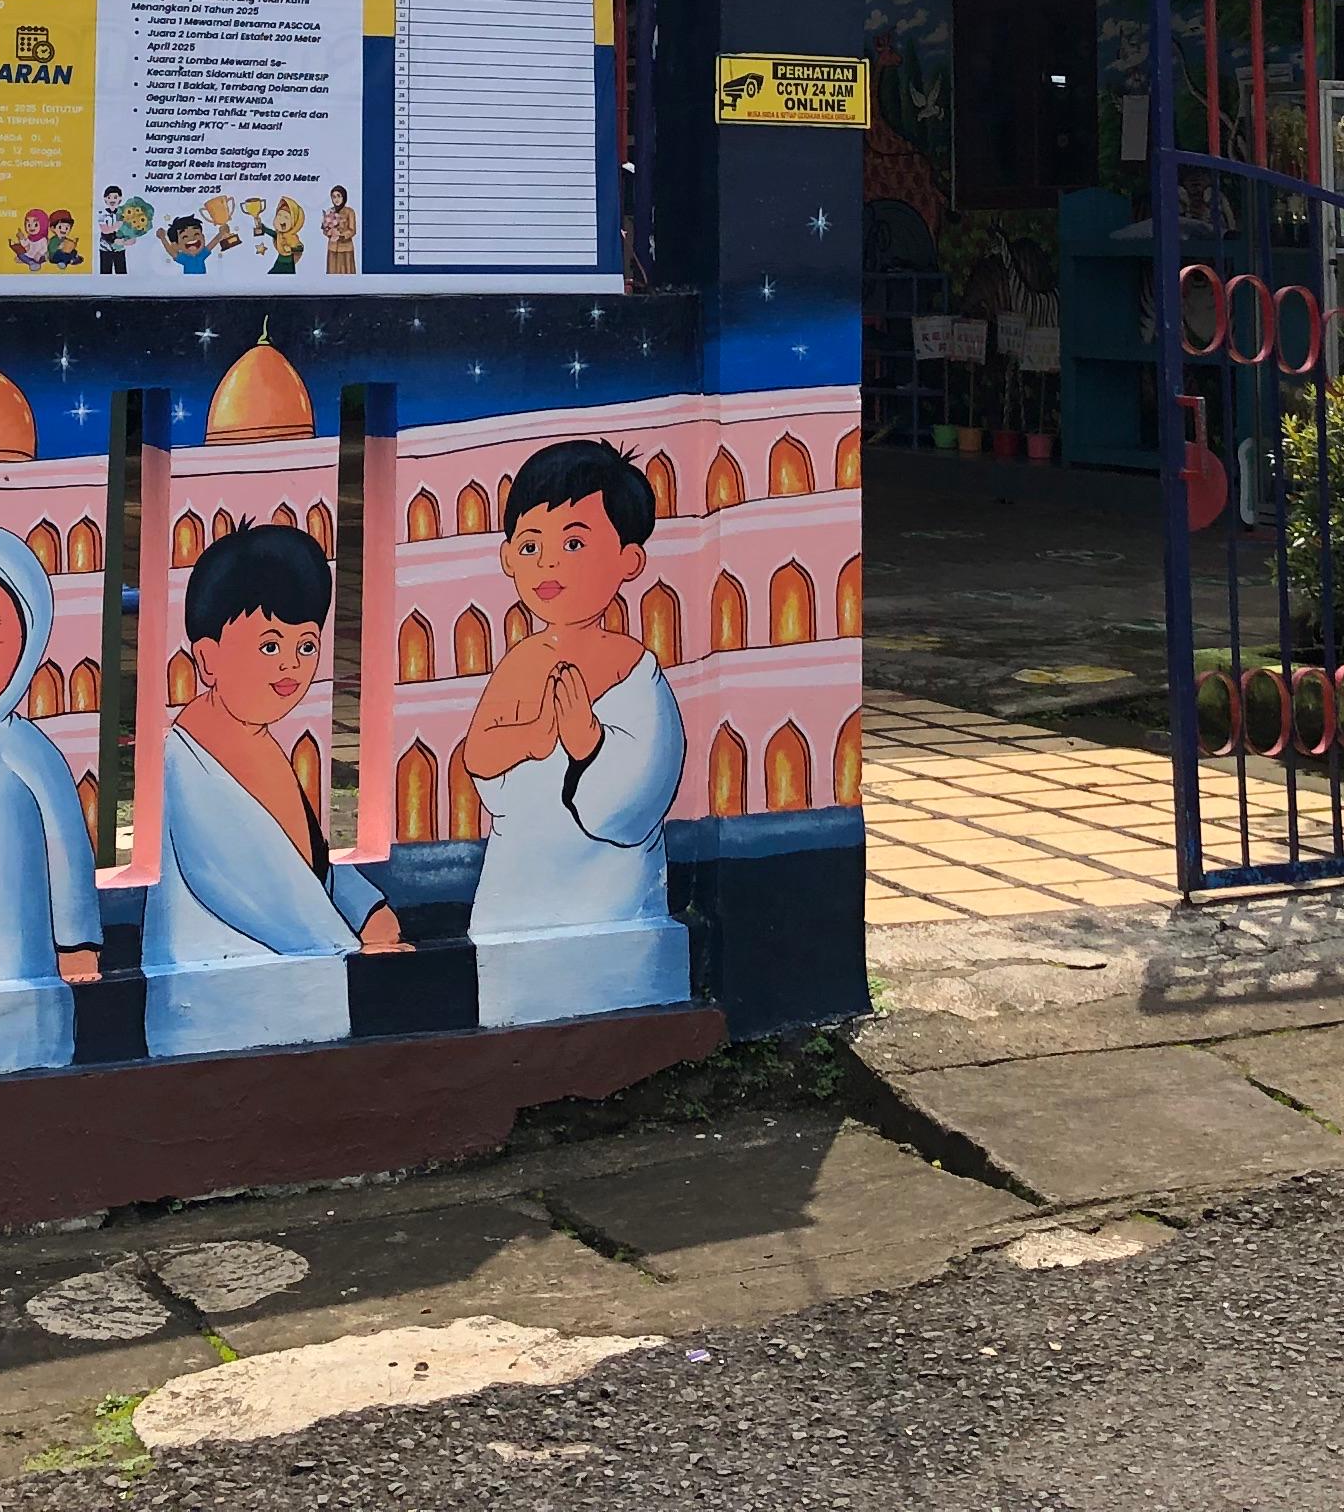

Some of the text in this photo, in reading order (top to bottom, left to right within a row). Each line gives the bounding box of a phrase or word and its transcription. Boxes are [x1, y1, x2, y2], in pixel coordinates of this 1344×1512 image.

[777, 66, 853, 80] PERHATIAN
[777, 82, 853, 97] CCTV 24 JAM
[785, 98, 846, 112] ONLINE
